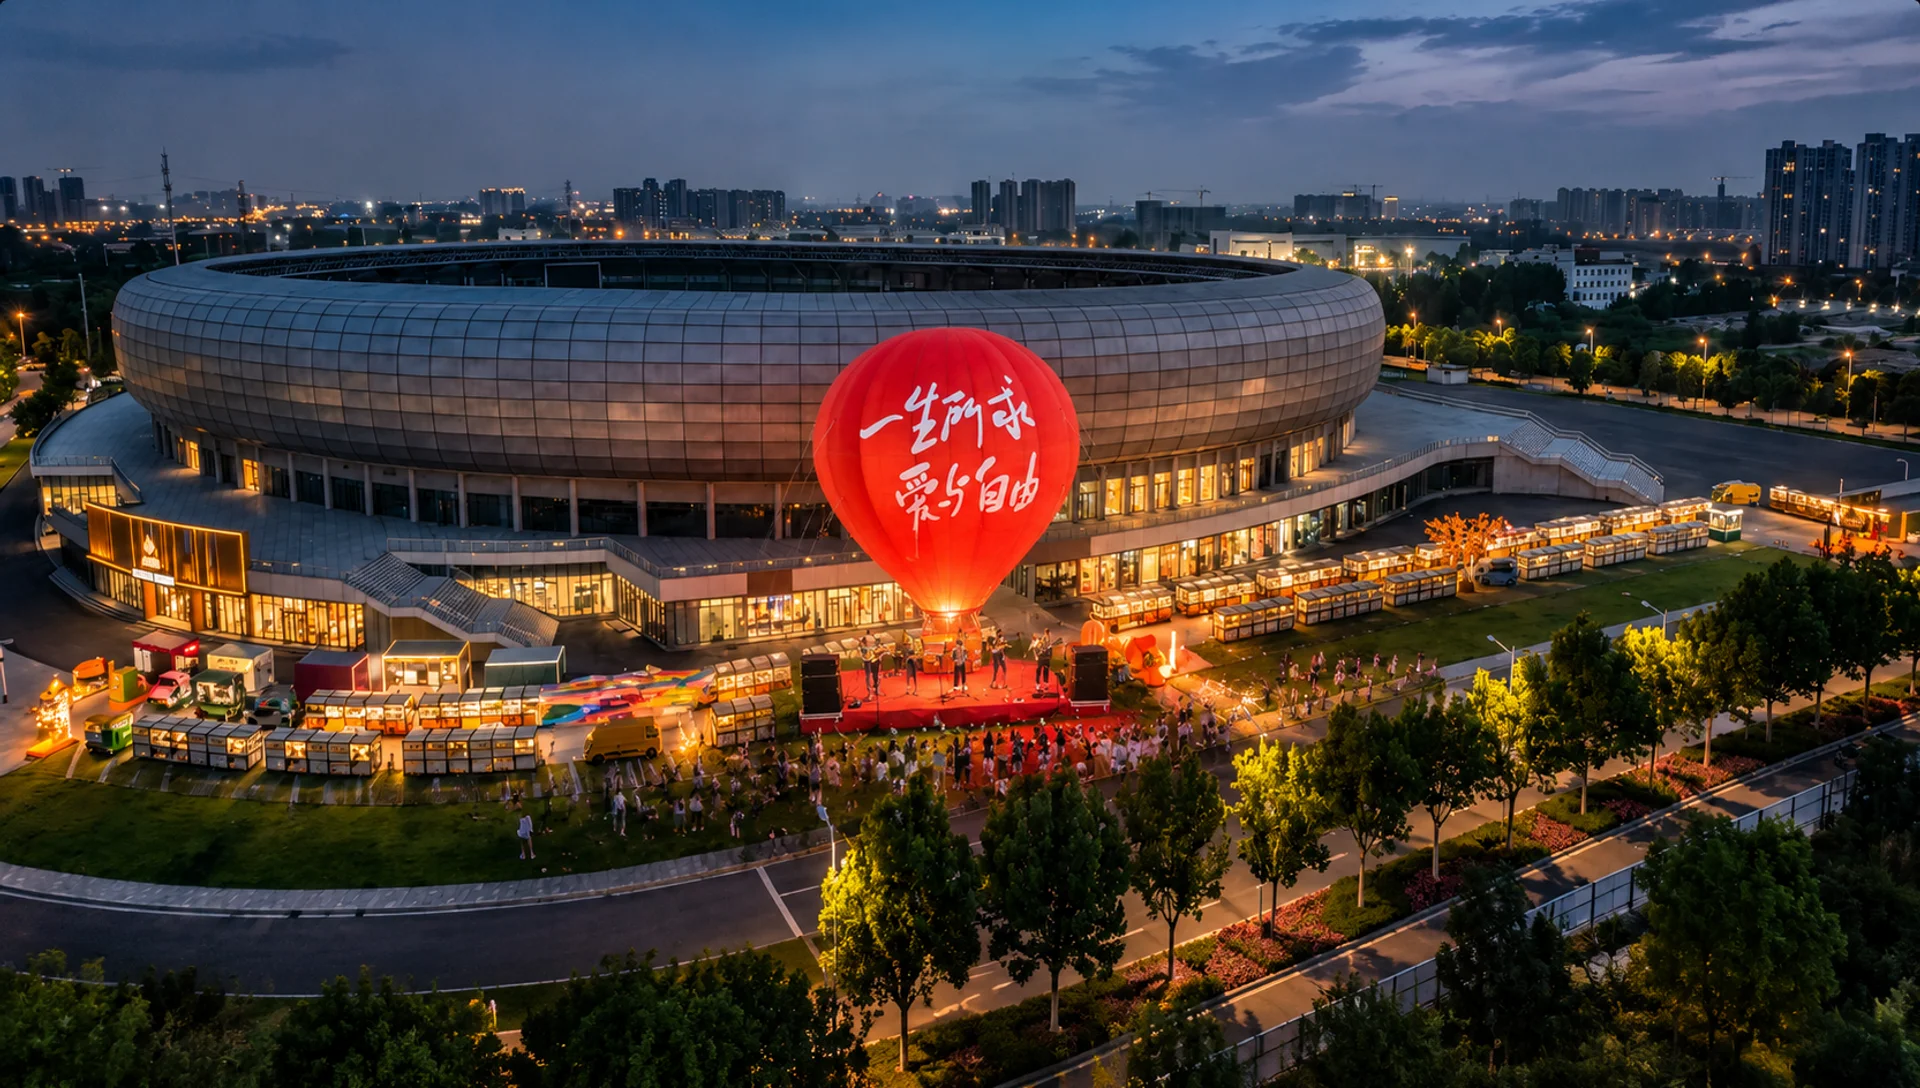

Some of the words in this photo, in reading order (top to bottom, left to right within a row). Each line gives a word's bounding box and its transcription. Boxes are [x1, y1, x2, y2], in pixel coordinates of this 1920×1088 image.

[859, 375, 1036, 455] 一生所求
[895, 451, 1040, 538] 爱与自由
